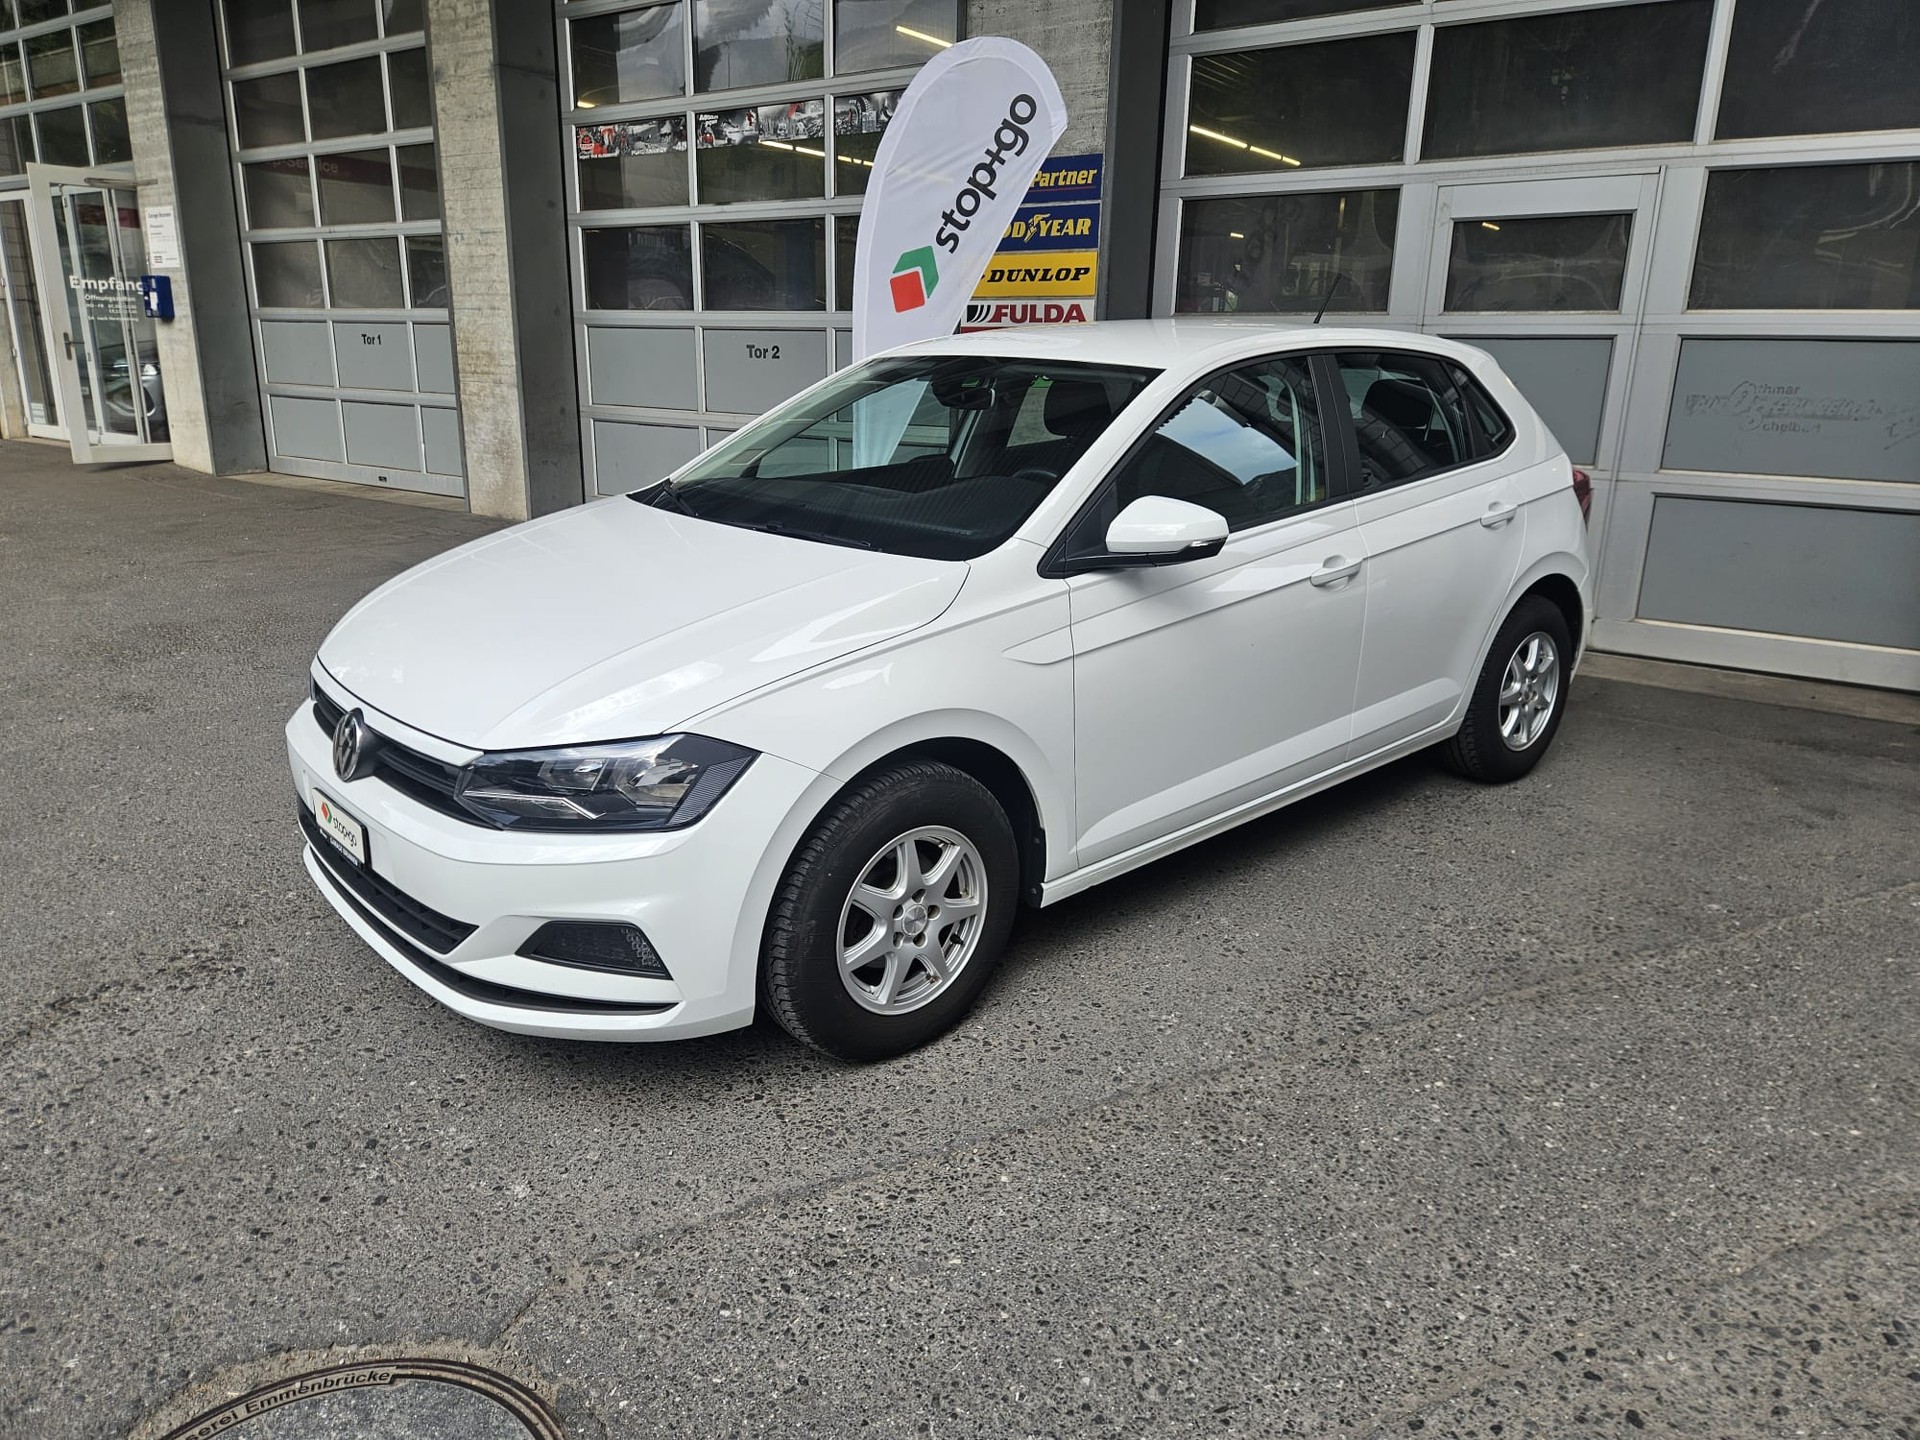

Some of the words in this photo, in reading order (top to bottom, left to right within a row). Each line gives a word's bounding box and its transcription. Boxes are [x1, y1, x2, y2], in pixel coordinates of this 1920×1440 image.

[936, 94, 1037, 254] stop+go
[1030, 169, 1097, 188] Partner
[987, 267, 1090, 283] DUNLOP
[69, 275, 146, 296] Empfang
[988, 304, 1086, 323] FULDA
[361, 333, 375, 345] Tor
[377, 334, 382, 345] 1
[746, 344, 768, 359] Tor
[771, 345, 780, 359] 2
[245, 1371, 391, 1415] Emmenbrücke
